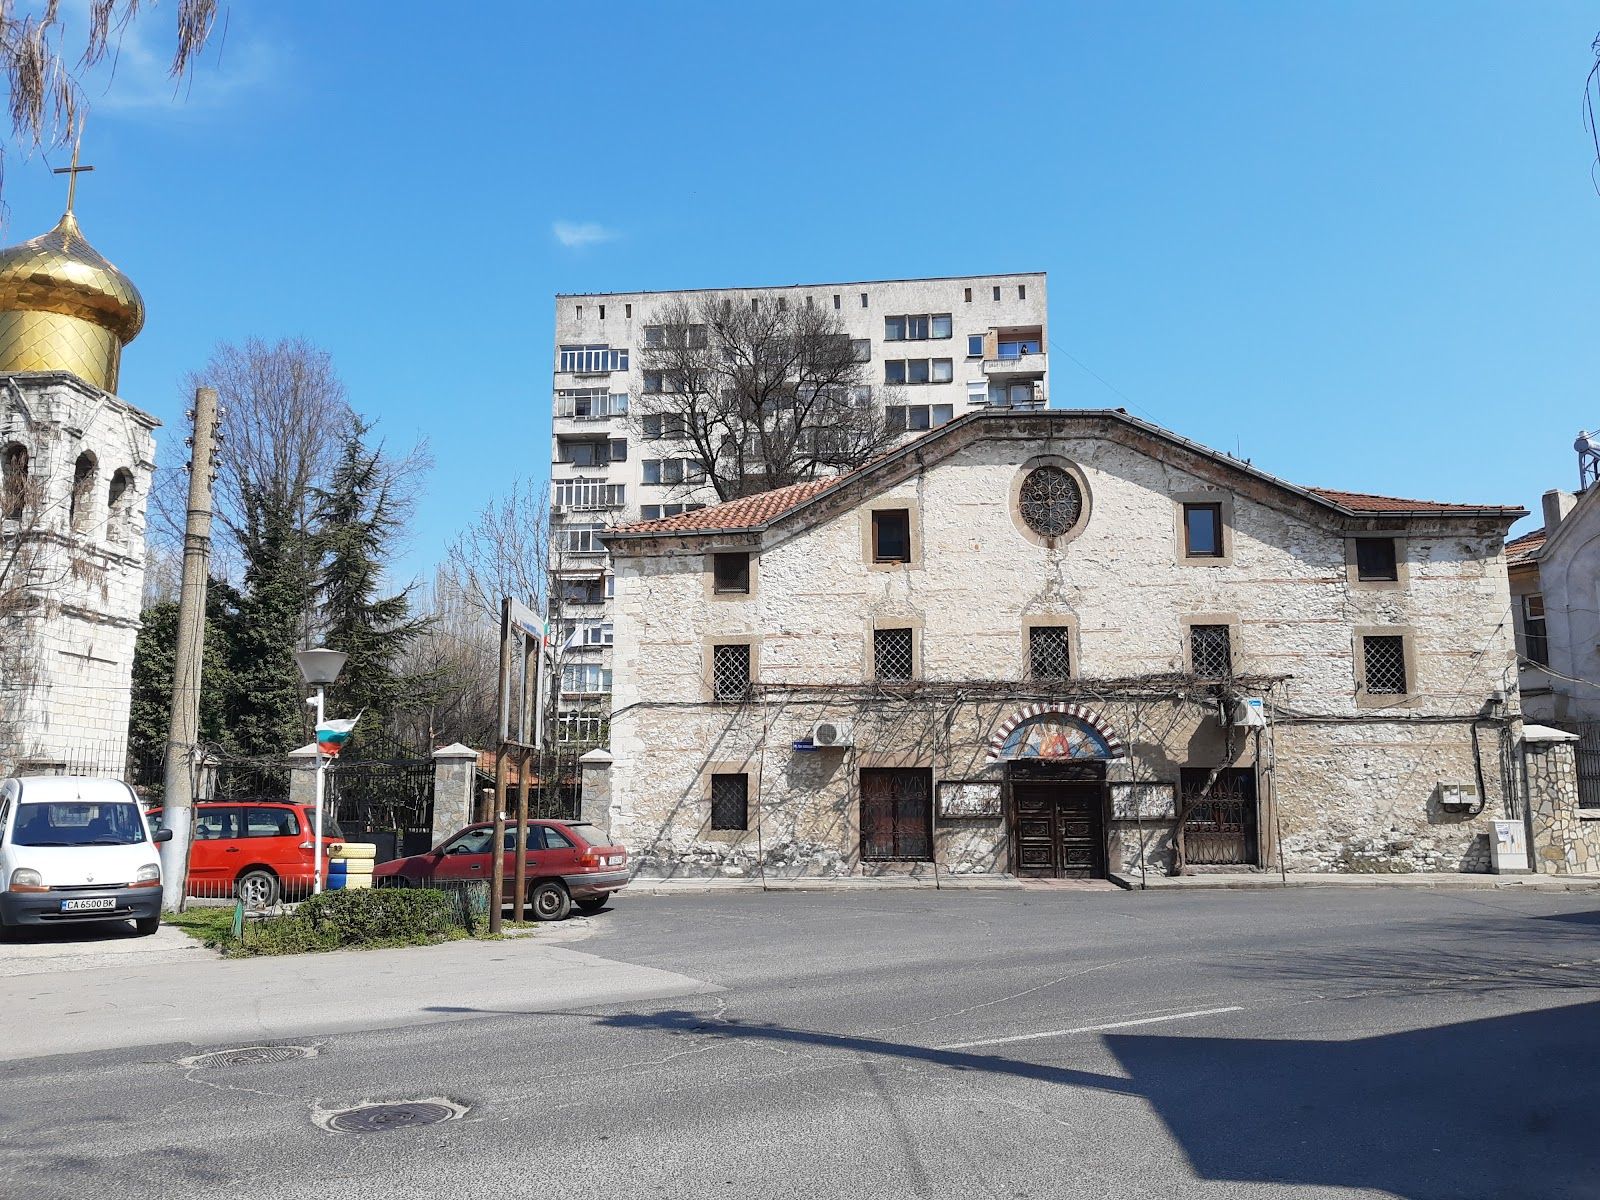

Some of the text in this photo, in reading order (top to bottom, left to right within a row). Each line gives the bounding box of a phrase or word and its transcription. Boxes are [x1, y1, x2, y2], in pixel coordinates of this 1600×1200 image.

[67, 899, 114, 909] CA 6500 BK
